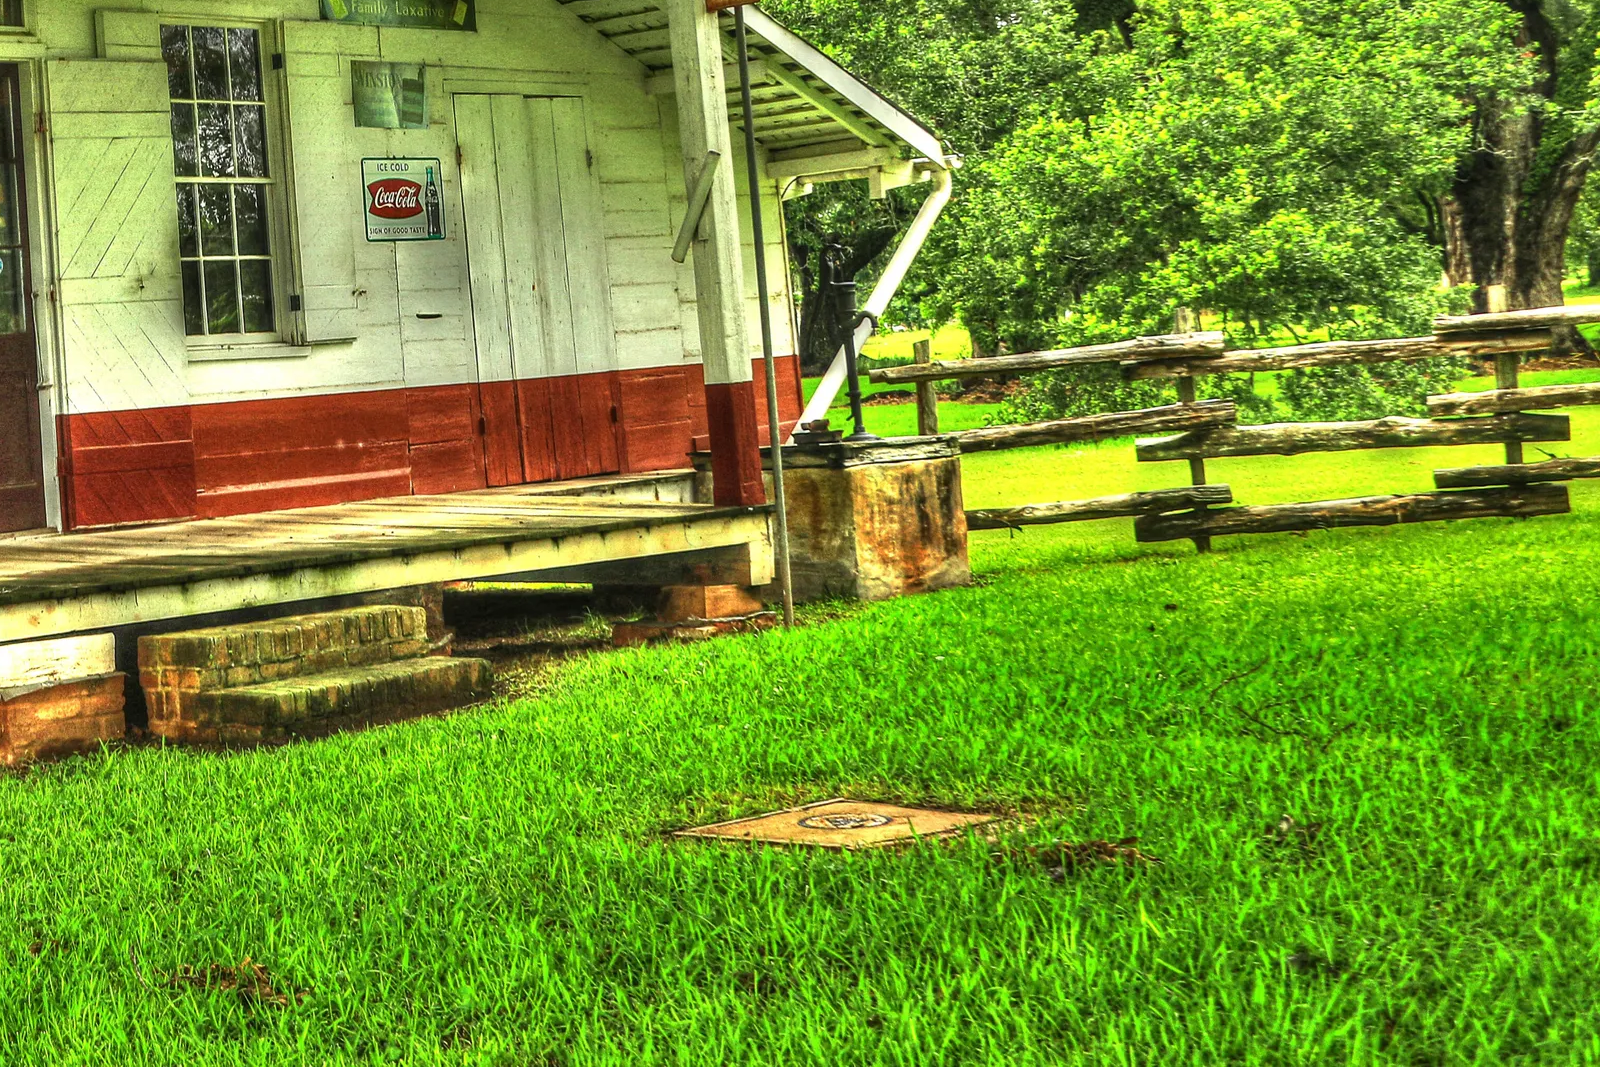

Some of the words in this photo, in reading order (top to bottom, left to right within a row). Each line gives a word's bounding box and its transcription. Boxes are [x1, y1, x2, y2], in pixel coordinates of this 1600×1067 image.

[395, 0, 445, 18] Laxative
[376, 163, 388, 172] ICE
[390, 163, 409, 172] COLD
[375, 186, 417, 209] Coca-Cola
